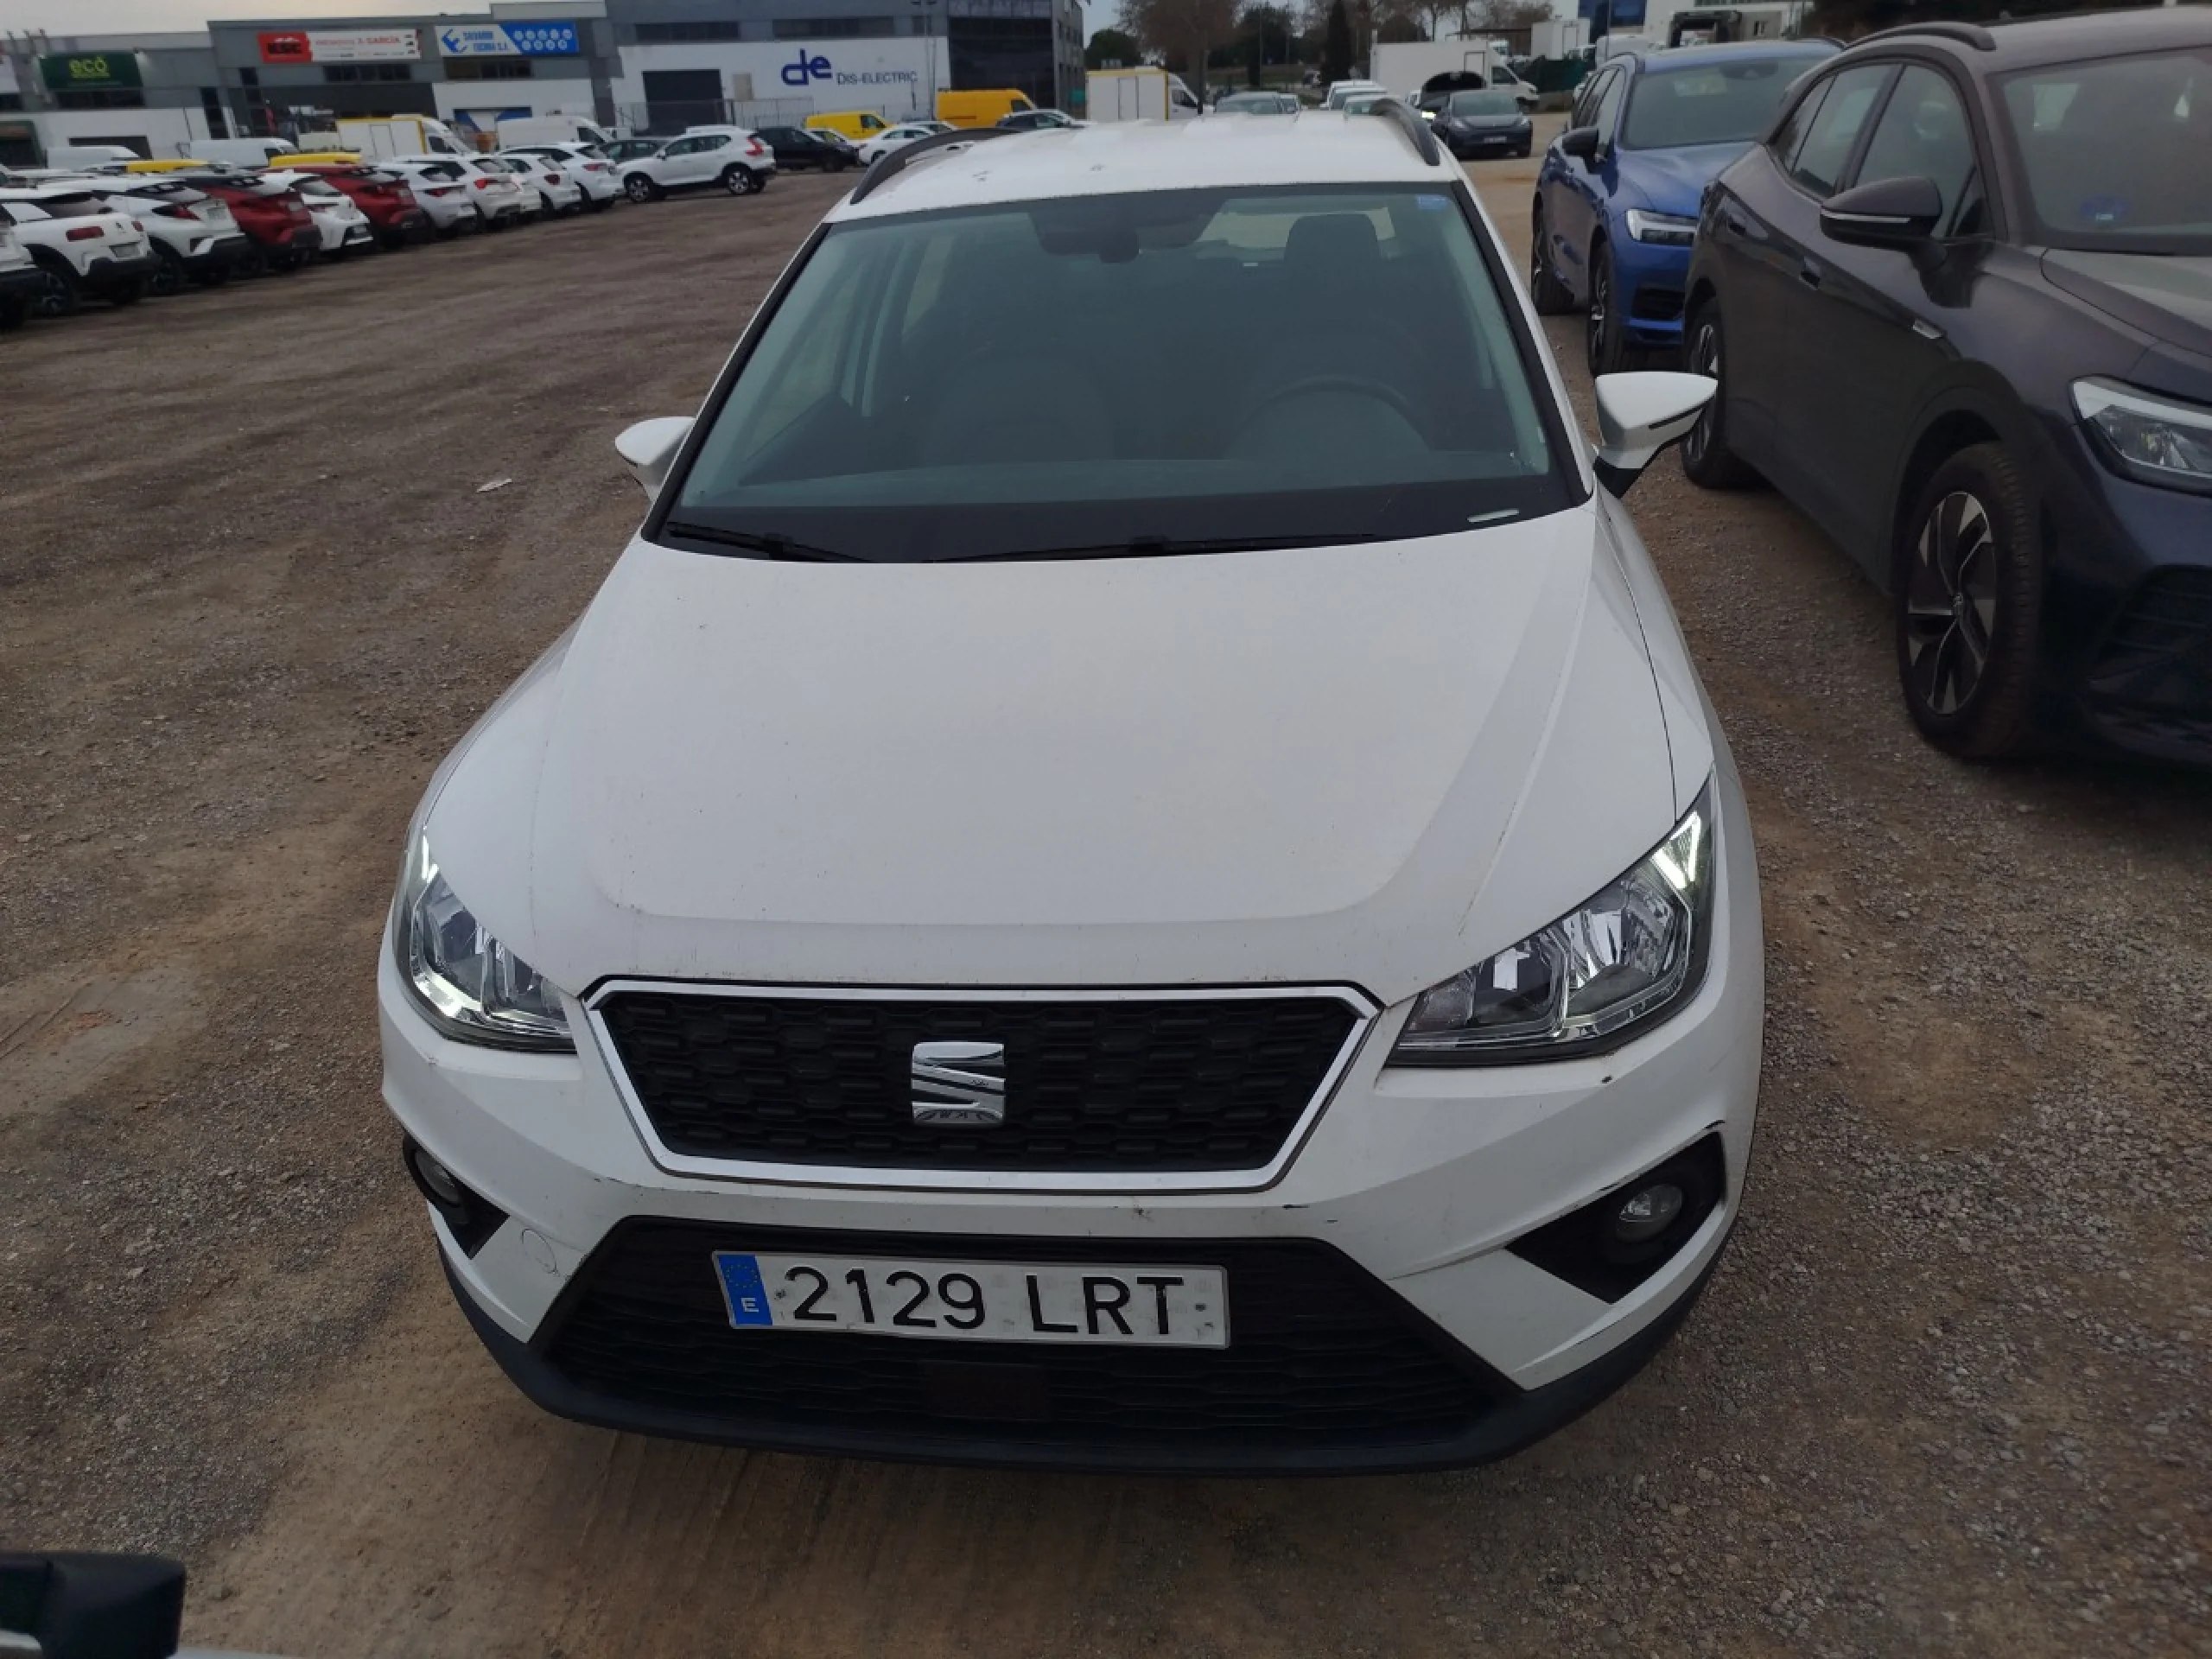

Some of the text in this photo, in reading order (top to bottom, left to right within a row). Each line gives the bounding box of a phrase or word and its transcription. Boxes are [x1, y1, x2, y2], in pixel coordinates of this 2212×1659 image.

[742, 1297, 759, 1313] E
[785, 1266, 1184, 1335] 2129 LRT
